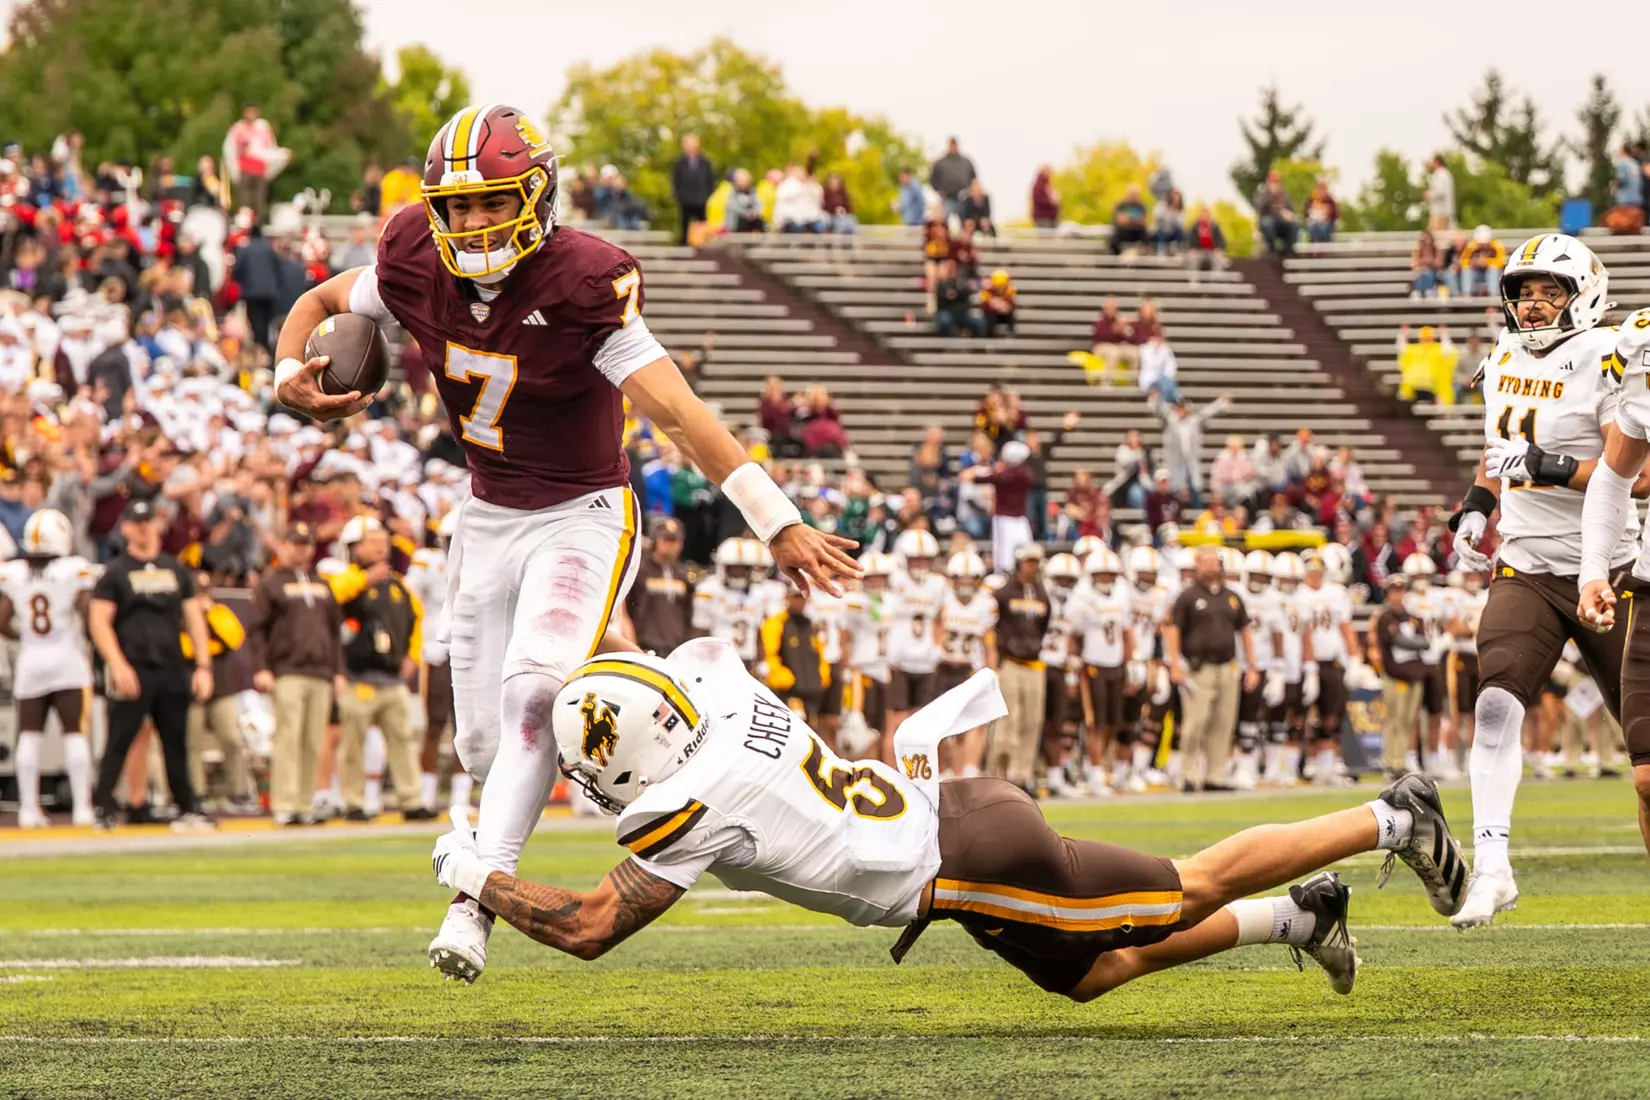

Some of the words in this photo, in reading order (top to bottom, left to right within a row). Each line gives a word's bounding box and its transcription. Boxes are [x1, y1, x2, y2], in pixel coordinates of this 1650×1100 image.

[611, 267, 641, 328] 7
[445, 340, 518, 452] 7
[1498, 374, 1564, 399] WYOMING
[29, 592, 52, 636] 8
[800, 734, 907, 820] 5
